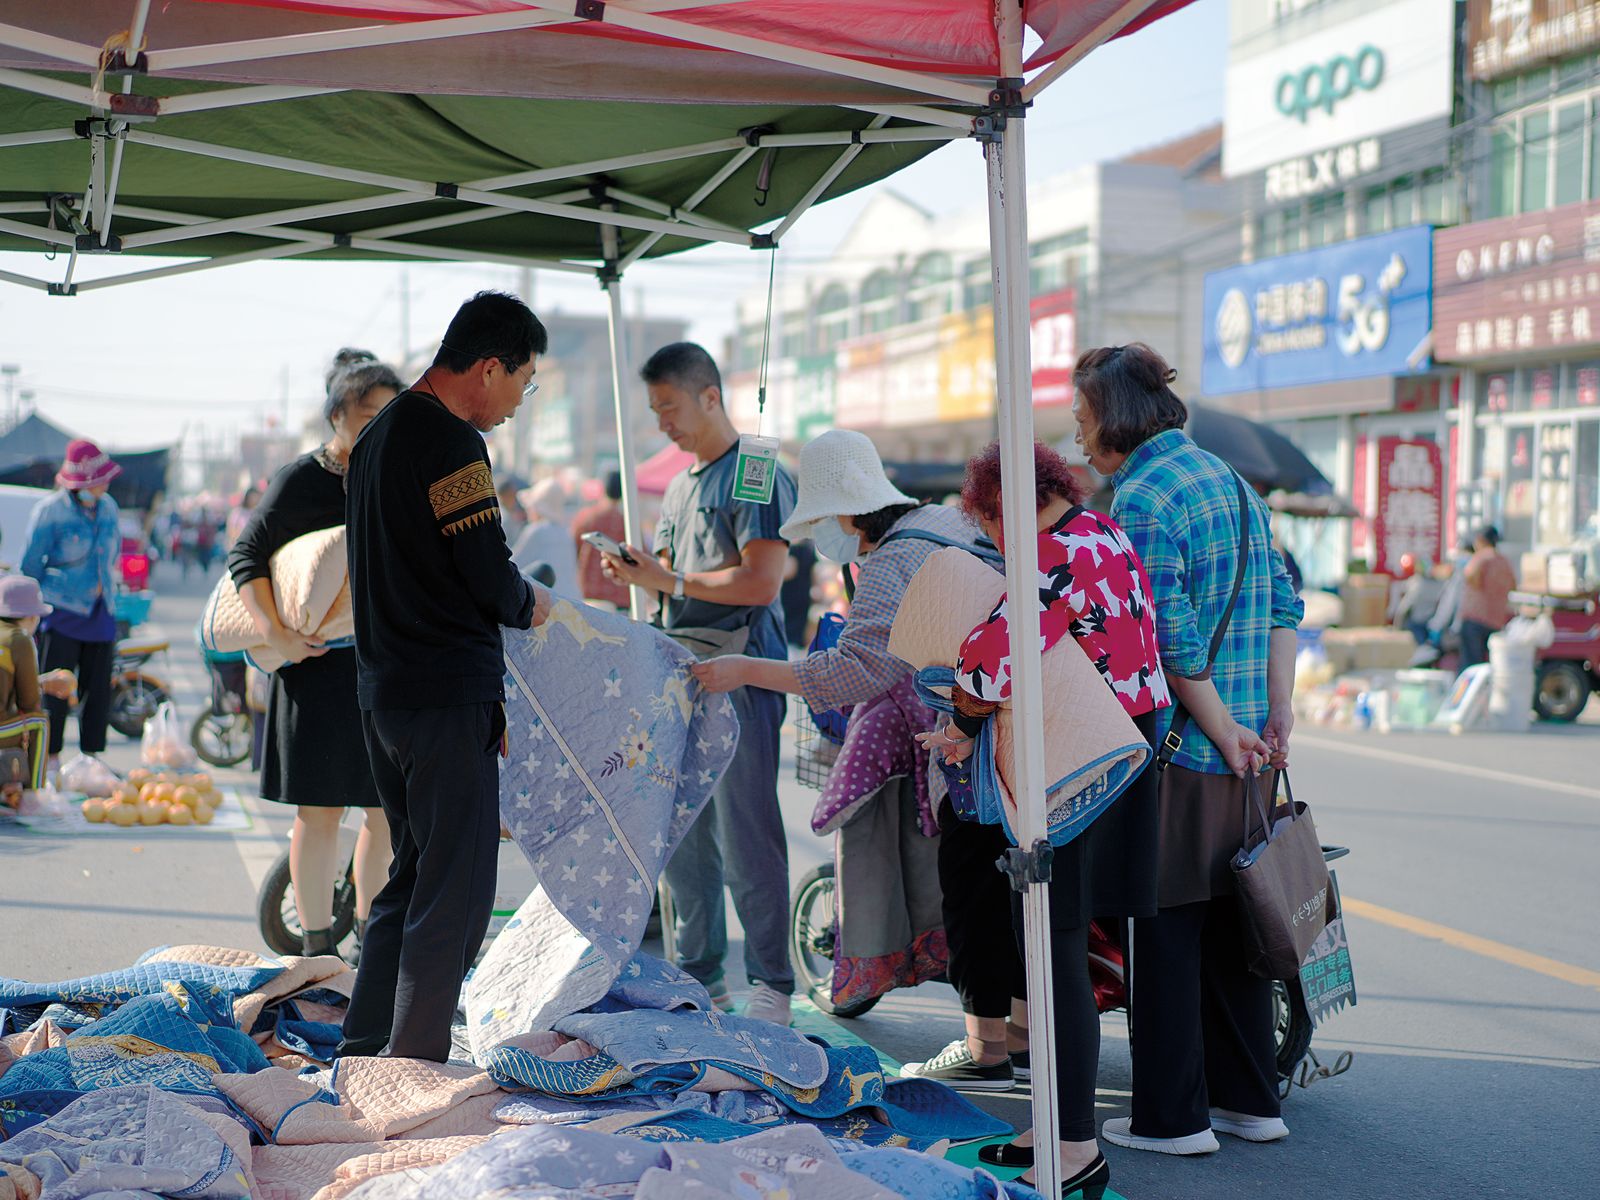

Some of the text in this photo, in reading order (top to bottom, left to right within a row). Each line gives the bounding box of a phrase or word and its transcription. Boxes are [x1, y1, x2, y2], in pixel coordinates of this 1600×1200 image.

[1336, 274, 1389, 357] 5G
[1307, 966, 1351, 1000] 上门服务
